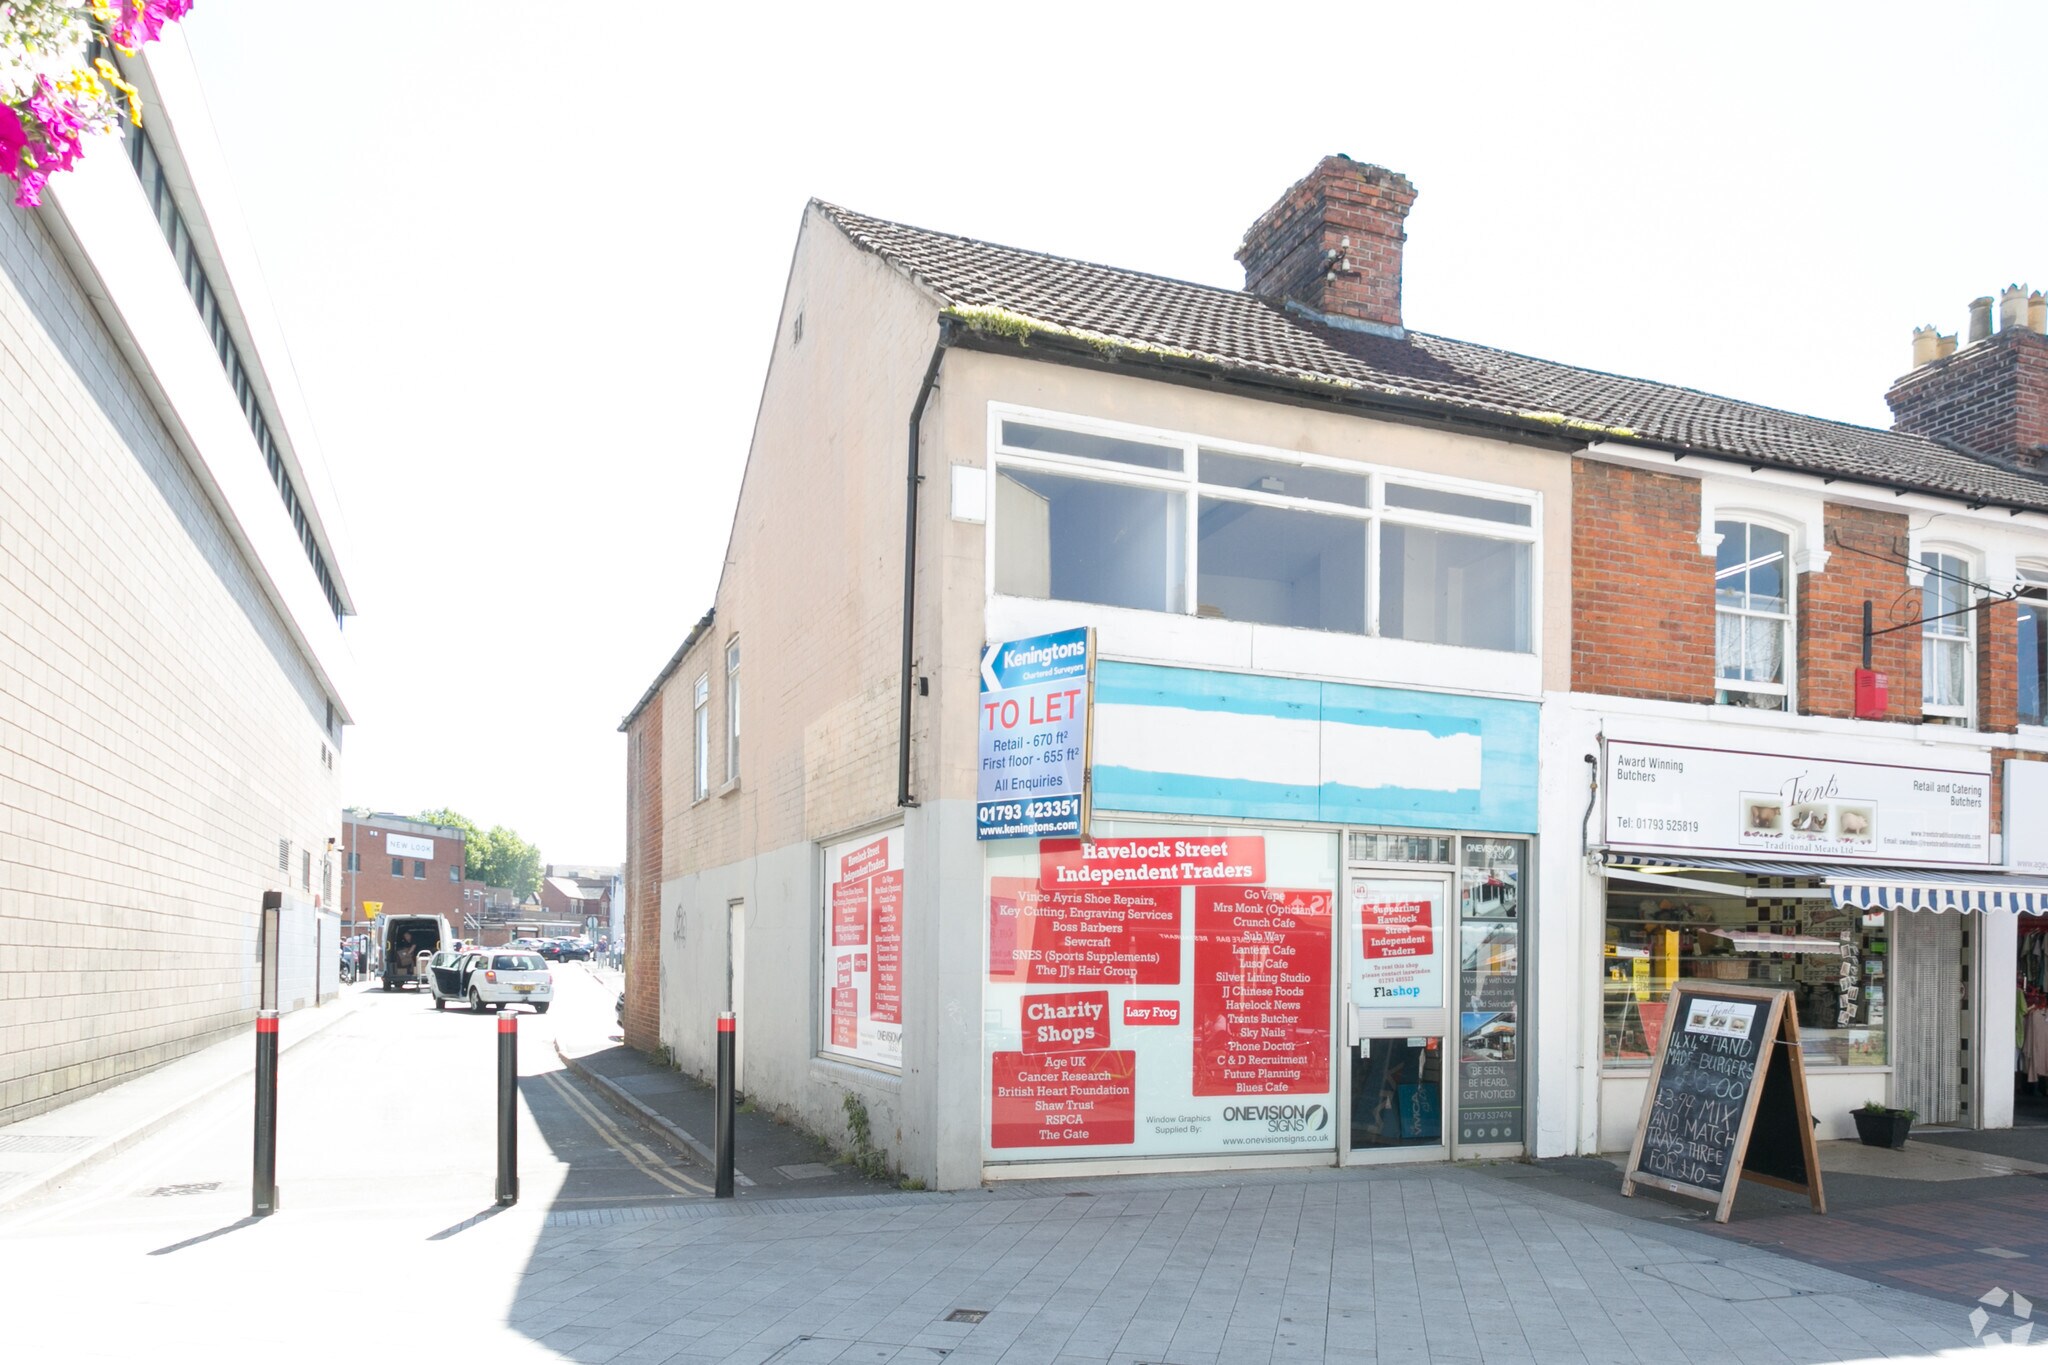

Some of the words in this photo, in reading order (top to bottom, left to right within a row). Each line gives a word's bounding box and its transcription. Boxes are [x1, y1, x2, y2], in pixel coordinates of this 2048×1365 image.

[1004, 641, 1085, 668] Keningtons
[1023, 668, 1053, 680] Chartered
[1054, 664, 1084, 675] Surveyors
[984, 699, 1019, 731] TO
[1029, 689, 1081, 724] LET
[993, 737, 1023, 752] Retail
[1033, 733, 1053, 747] 670
[982, 757, 1005, 770] First
[1008, 755, 1034, 767] floor
[1044, 750, 1063, 763] 655
[1618, 755, 1646, 768] Award
[1648, 757, 1684, 773] Winning
[1617, 769, 1656, 782] Butchers
[994, 779, 1008, 791] All
[1011, 774, 1063, 791] Enquiries
[1913, 780, 1934, 792] Retail
[1937, 783, 1950, 794] and
[1952, 783, 1982, 797] Catering
[1950, 796, 1982, 808] Butchers
[979, 804, 1021, 822] 01793
[1025, 799, 1078, 818] 423351
[980, 821, 1078, 835] www.keningtons.com
[1617, 817, 1634, 828] Tel:
[1636, 818, 1664, 830] 01793
[1666, 820, 1699, 832] 525819
[390, 841, 408, 849] NEW
[411, 844, 431, 852] LOOK
[1081, 842, 1170, 859] Havelock
[1174, 841, 1228, 857] Street
[1765, 841, 1812, 852] Traditional
[1815, 844, 1839, 854] Meats
[1840, 846, 1854, 854] Ltd
[1056, 864, 1178, 885] Independent
[1181, 863, 1252, 879] Traders
[1018, 891, 1049, 902] Vince
[1053, 892, 1082, 905] Ayris
[1084, 893, 1110, 904] Shoe
[1113, 894, 1157, 906] Repairs,
[1244, 890, 1259, 900] Go
[1261, 890, 1285, 903] Vape
[999, 905, 1021, 918] Key
[1023, 906, 1067, 919] Cutting,
[1069, 908, 1126, 921] Engraving
[1127, 909, 1173, 920] Services
[1213, 902, 1233, 912] Mrs
[1235, 902, 1263, 913] Monk
[1265, 903, 1315, 917] (Optician)
[1373, 904, 1420, 915] Supporting
[1233, 917, 1270, 927] Crunch
[1272, 917, 1296, 928] Cafe
[1377, 914, 1417, 924] Havelock
[1052, 921, 1078, 932] Boss
[1080, 922, 1123, 933] Barbers
[1385, 926, 1411, 935] Street
[1064, 936, 1111, 947] Sewcraft
[1243, 931, 1262, 941] Sub
[1264, 931, 1285, 943] Way
[1371, 935, 1425, 947] Independent
[1232, 944, 1270, 955] Lantern
[1272, 945, 1296, 956] Cafe
[1382, 947, 1416, 956] Traders
[1012, 950, 1042, 961] SNES
[1045, 951, 1084, 963] (Sports
[1086, 951, 1160, 964] Supplements)
[1239, 958, 1263, 969] Luso
[1265, 959, 1288, 969] Cafe
[1036, 965, 1057, 975] The
[1059, 965, 1075, 977] JJ's
[1077, 965, 1101, 976] Hair
[1103, 966, 1138, 979] Group
[1216, 972, 1245, 982] Silver
[1247, 972, 1278, 984] Lining
[1280, 972, 1311, 983] Studio
[1489, 976, 1502, 984] with
[1222, 986, 1230, 998] JJ
[1232, 986, 1273, 996] Chinese
[1275, 986, 1304, 996] Foods
[1373, 986, 1420, 997] Flashop
[1503, 988, 1514, 996] and
[1027, 1001, 1103, 1021] Charity
[1226, 1000, 1272, 1010] Havelock
[1273, 1000, 1301, 1010] News
[1126, 1006, 1151, 1019] Lazy
[1152, 1006, 1178, 1020] Frog
[1228, 1013, 1259, 1024] Trents
[1261, 1013, 1298, 1024] Butcher
[1037, 1025, 1095, 1044] Shops
[1240, 1027, 1258, 1039] Sky
[1260, 1027, 1286, 1037] Nails
[1229, 1041, 1261, 1051] Phone
[1263, 1041, 1296, 1051] Doctor
[1711, 1036, 1752, 1058] HAND
[1044, 1057, 1067, 1069] Age
[1070, 1056, 1086, 1067] UK
[1217, 1055, 1225, 1065] C
[1227, 1056, 1236, 1065] &
[1238, 1056, 1246, 1065] D
[1248, 1055, 1307, 1065] Recruitment
[1665, 1048, 1693, 1066] MADE
[1699, 1053, 1754, 1079] BURGERS
[1017, 1071, 1059, 1082] Cancer
[1061, 1071, 1111, 1081] Research
[1224, 1069, 1255, 1079] Future
[1258, 1068, 1301, 1080] Planning
[1472, 1066, 1482, 1075] BE
[1236, 1082, 1263, 1092] Blues
[1265, 1082, 1288, 1092] Cafe
[1468, 1079, 1479, 1087] BE
[998, 1086, 1034, 1097] British
[1036, 1086, 1068, 1096] Heart
[1070, 1085, 1130, 1096] Foundation
[1463, 1090, 1478, 1099] GET
[1480, 1090, 1516, 1099] NOTICED
[1035, 1100, 1064, 1111] Shaw
[1066, 1100, 1094, 1110] Trust
[1222, 1105, 1304, 1121] ONEVISION
[1464, 1111, 1486, 1120] 01793
[1487, 1110, 1512, 1119] 537474
[1698, 1099, 1738, 1131] MIX
[1045, 1114, 1084, 1125] RSPCA
[1146, 1115, 1176, 1124] Window
[1178, 1114, 1211, 1125] Graphics
[1155, 1125, 1188, 1135] Supplied
[1190, 1125, 1202, 1135] By:
[1267, 1119, 1304, 1133] SIGNS
[1651, 1109, 1679, 1132] AND
[1683, 1119, 1736, 1147] MATCH
[1039, 1129, 1061, 1140] The
[1062, 1129, 1090, 1140] Gate
[1222, 1134, 1329, 1145] www.onevisionsigns.co.uk
[1648, 1126, 1684, 1153] TRAYS
[1688, 1141, 1723, 1165] THREE
[1649, 1149, 1678, 1174] FOR
